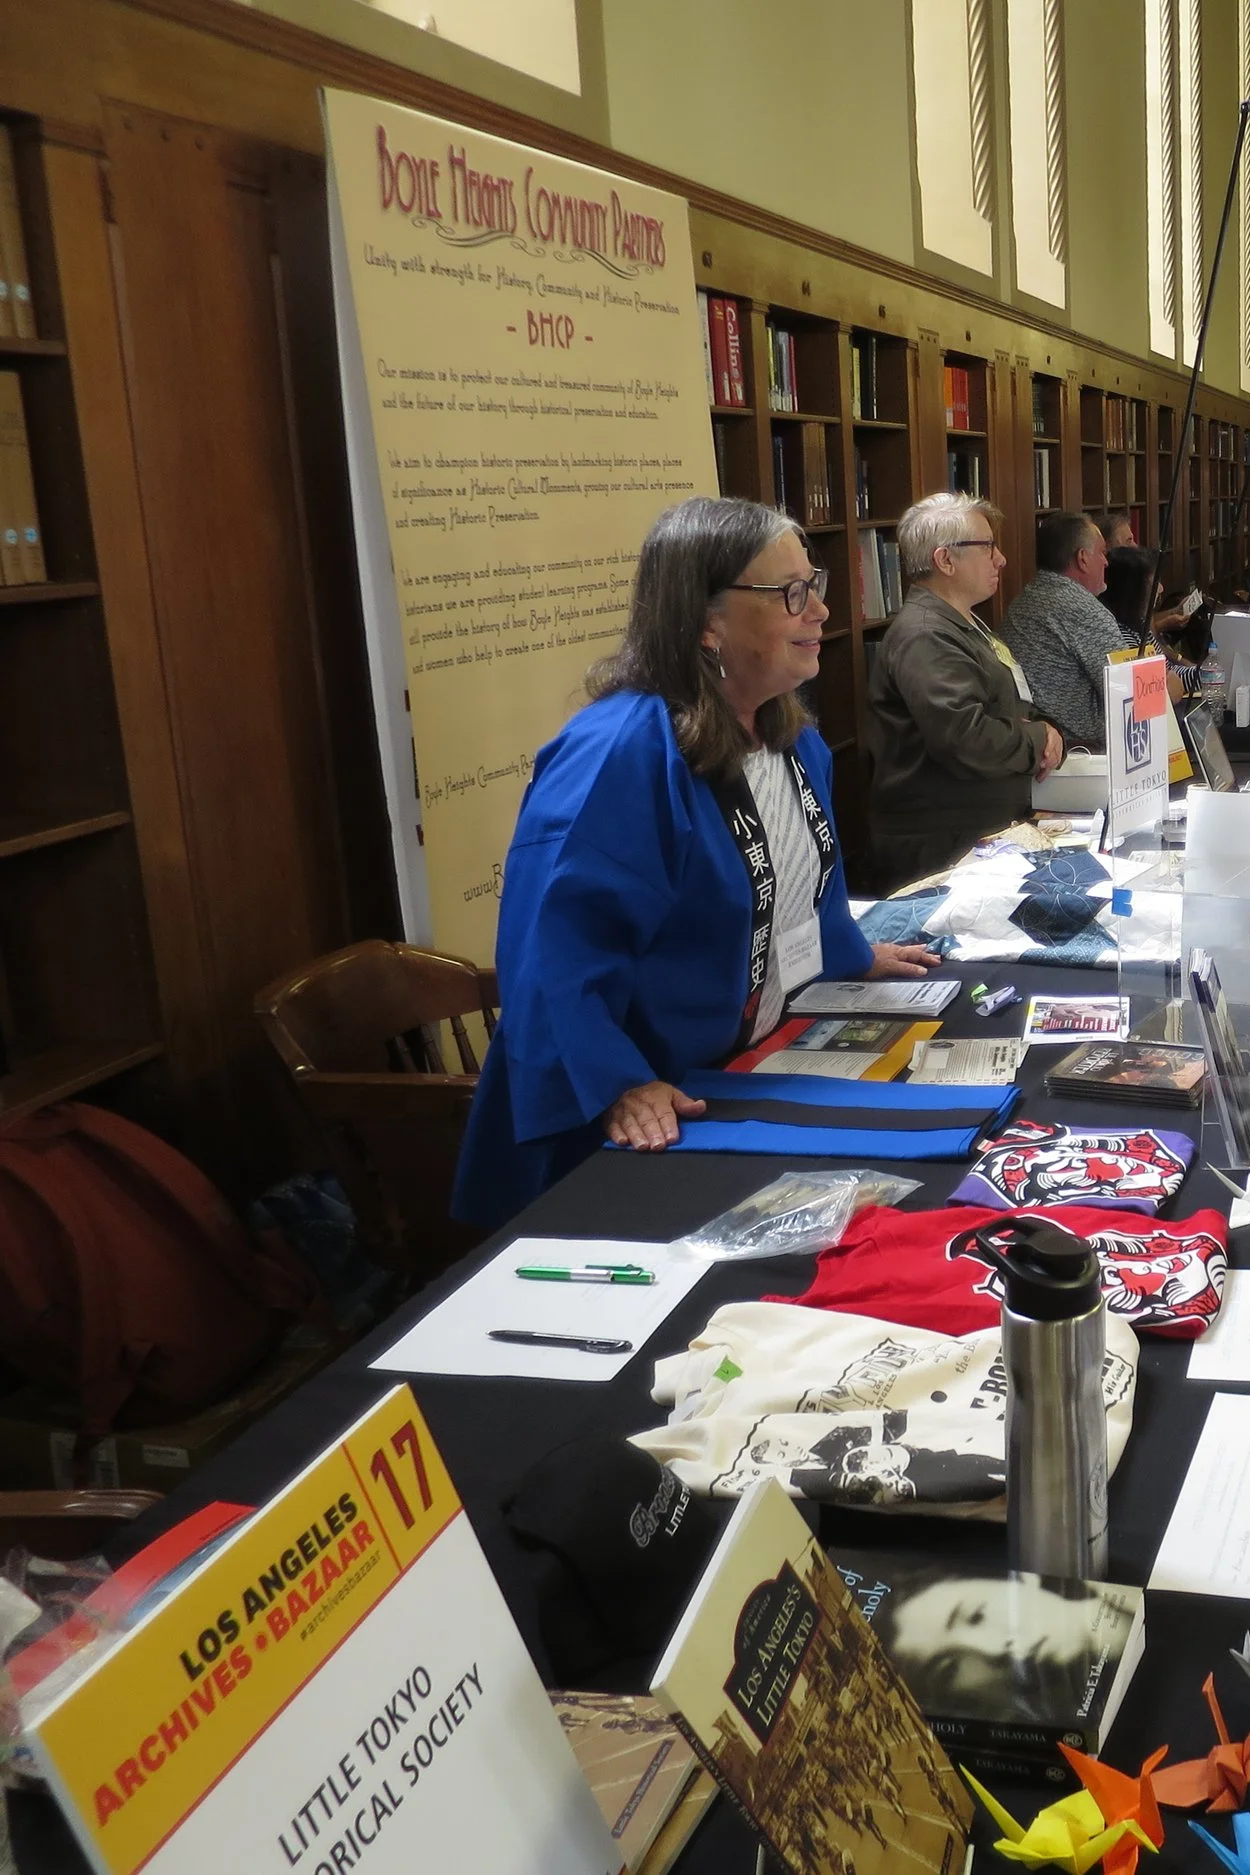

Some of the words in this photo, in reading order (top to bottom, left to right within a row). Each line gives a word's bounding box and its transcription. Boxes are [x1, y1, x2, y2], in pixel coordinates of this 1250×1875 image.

[364, 243, 397, 276] Unity
[401, 254, 425, 273] with
[430, 259, 474, 286] strength
[478, 264, 492, 283] for
[536, 273, 583, 304] Community
[585, 284, 600, 301] and
[603, 285, 632, 307] Historic
[634, 291, 680, 314] Preservation
[526, 309, 575, 350] BHCP
[1142, 769, 1167, 792] TOKYO
[733, 808, 774, 911] 小東京
[751, 922, 770, 993] 歴史
[955, 1354, 970, 1375] the
[370, 1420, 436, 1532] 17
[664, 1492, 690, 1537] LITTLE
[179, 1610, 242, 1682] LOS
[241, 1492, 359, 1623] ANGELES
[299, 1548, 383, 1642] #archivesbazaar
[92, 1643, 254, 1827] ARCHIVES
[265, 1520, 376, 1643] BAZAAR
[738, 1667, 763, 1709] LOS
[757, 1584, 801, 1672] ANGELES'S
[756, 1664, 791, 1727] LITTLE
[782, 1611, 813, 1666] TOKYO
[400, 1662, 484, 1788] SOCIETY
[930, 1721, 967, 1735] HOLY
[989, 1728, 1047, 1743] TAKAYAMA
[1076, 1687, 1096, 1717] Patricia
[277, 1752, 363, 1868] LITTLE
[355, 1665, 432, 1766] TOKYO
